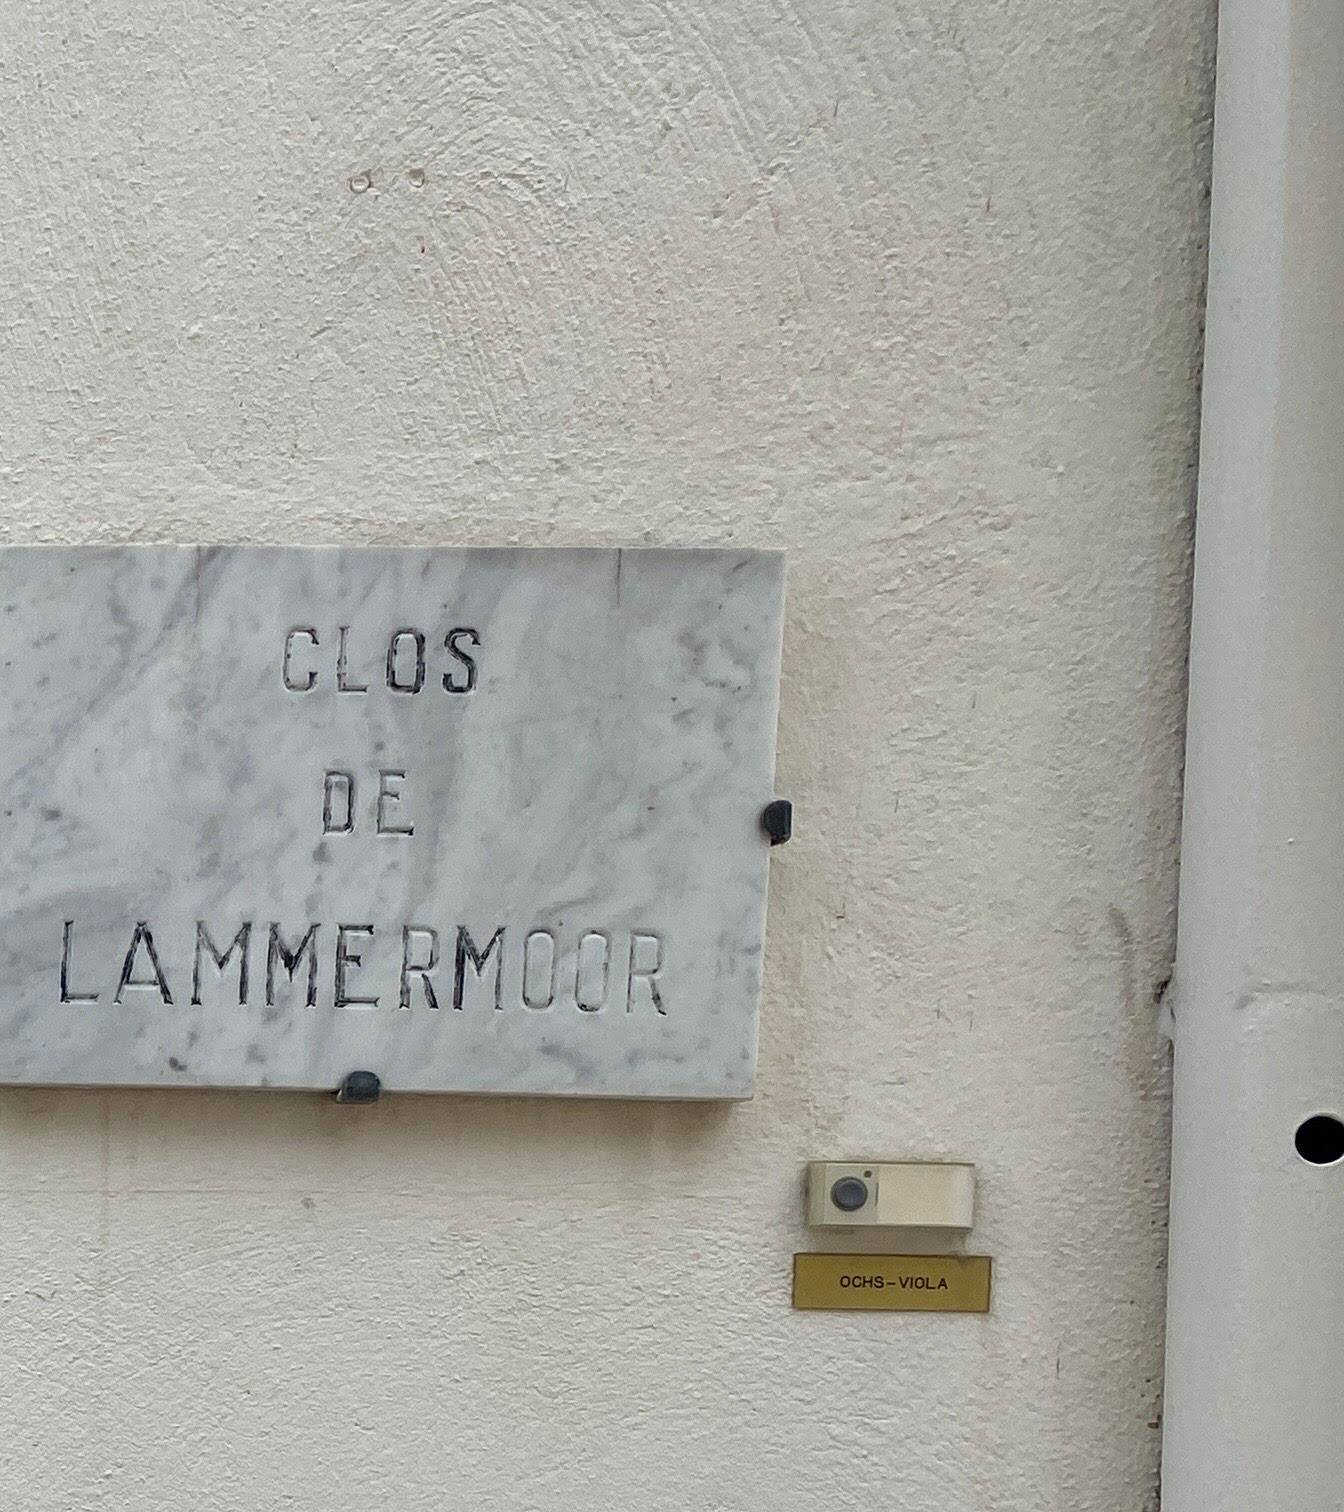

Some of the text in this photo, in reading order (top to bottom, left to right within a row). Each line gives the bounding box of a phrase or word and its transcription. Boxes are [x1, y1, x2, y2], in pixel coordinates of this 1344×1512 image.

[282, 626, 484, 696] CLOS
[321, 769, 416, 838] DE
[59, 919, 669, 1016] LAMMERMOOR
